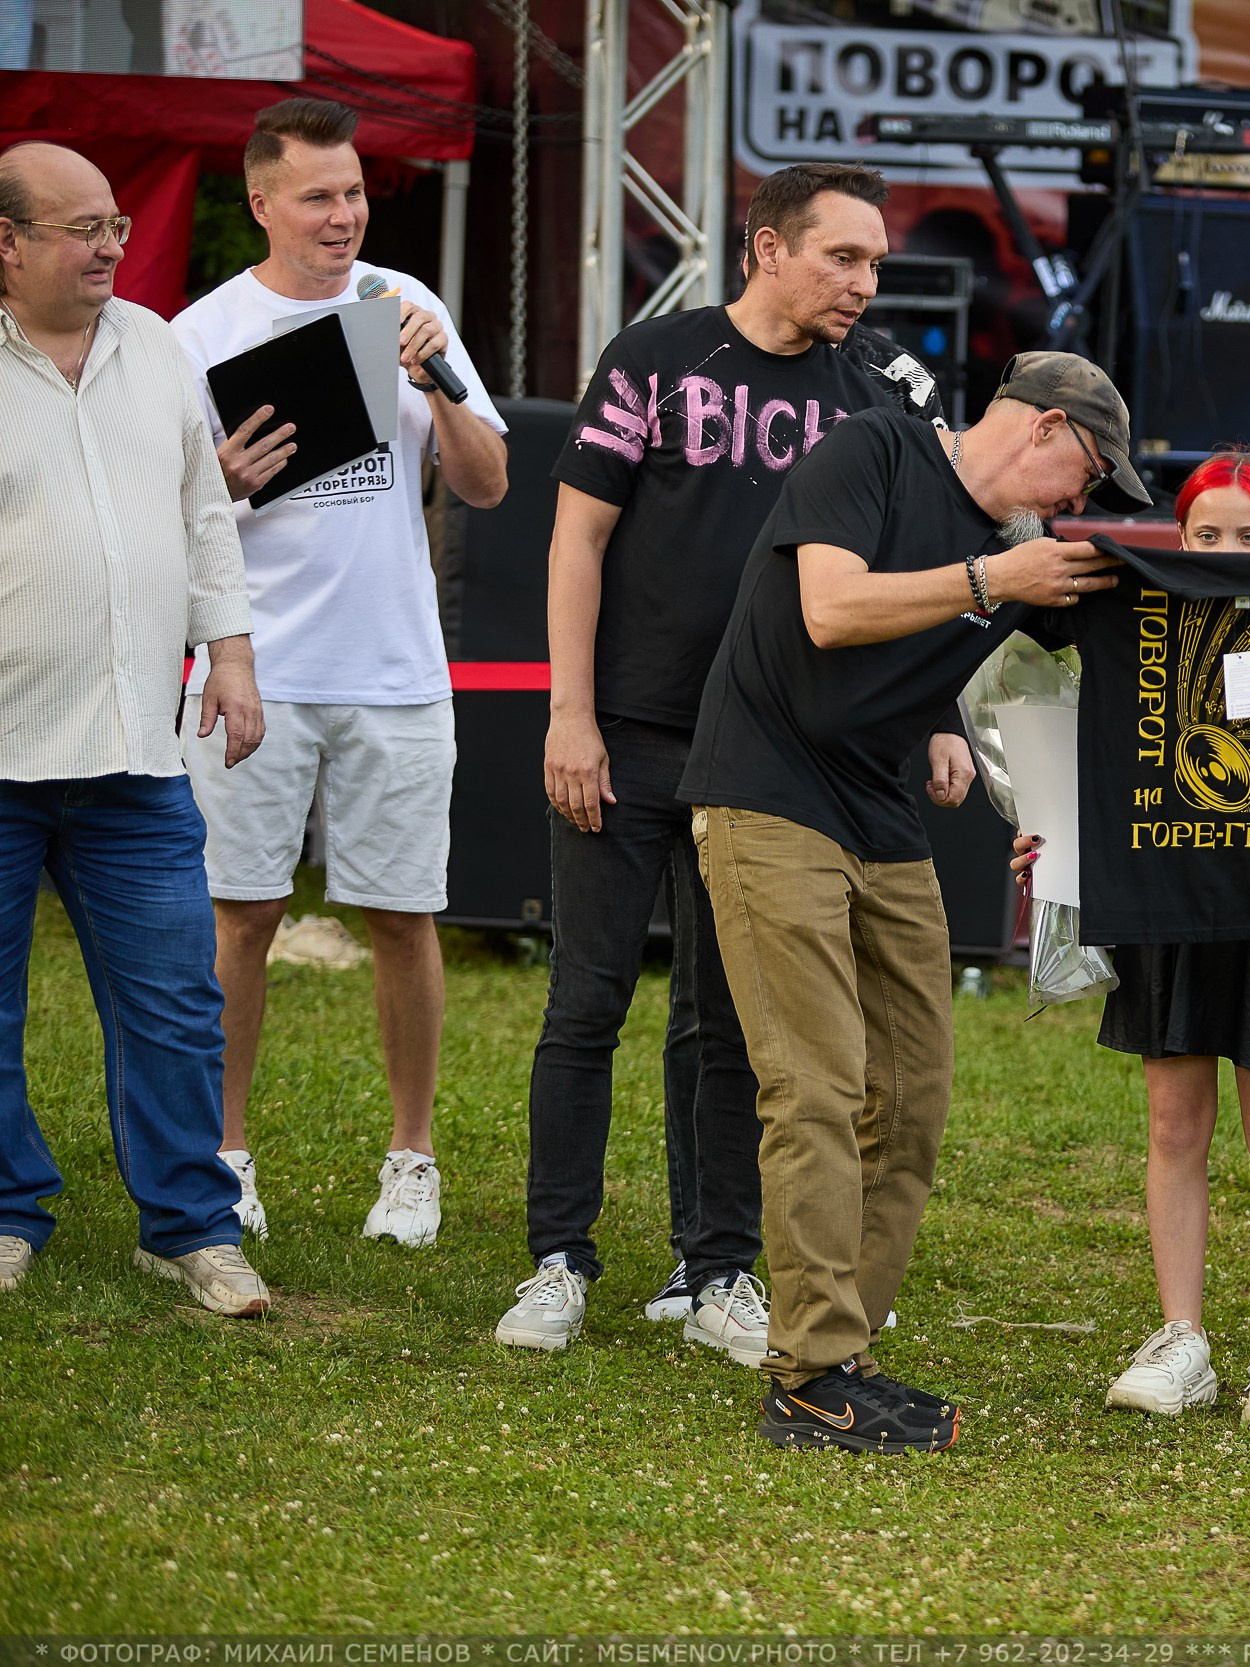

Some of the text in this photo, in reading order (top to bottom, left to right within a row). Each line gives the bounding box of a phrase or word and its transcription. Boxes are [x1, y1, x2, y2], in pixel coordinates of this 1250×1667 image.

[351, 475, 388, 488] ГРЯЗЬ
[313, 496, 359, 509] СОСНОВЫЙ
[1133, 588, 1168, 766] ПОВОРОТ
[1134, 787, 1163, 811] на
